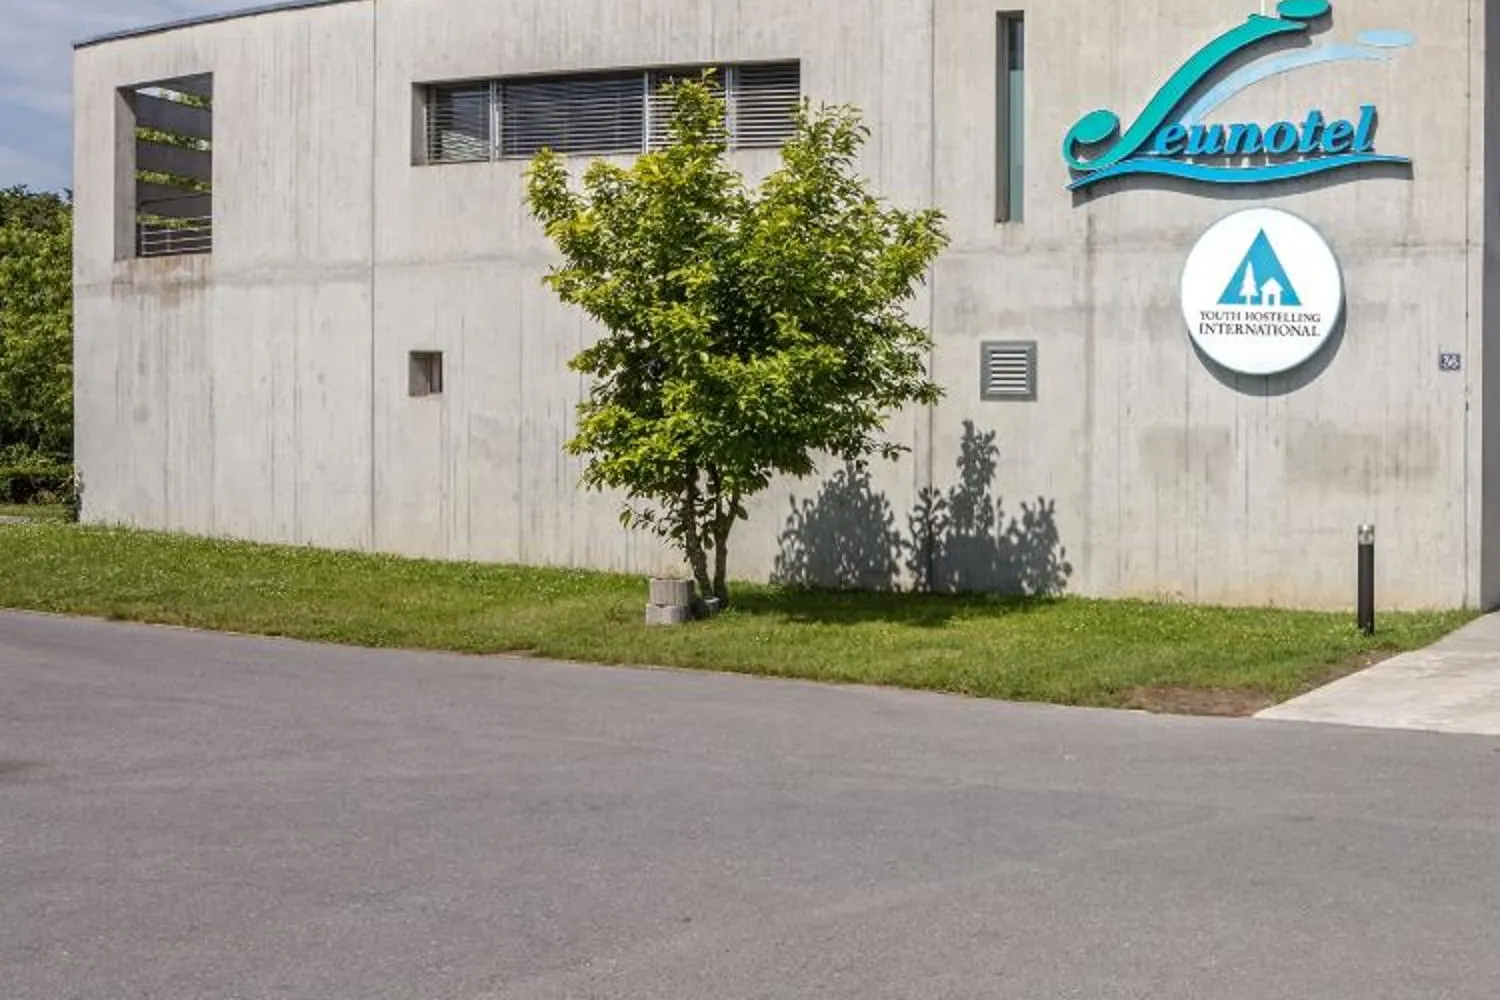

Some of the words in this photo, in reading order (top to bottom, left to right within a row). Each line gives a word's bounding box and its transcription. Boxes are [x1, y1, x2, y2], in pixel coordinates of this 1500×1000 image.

[1199, 310, 1241, 321] YOUTH
[1245, 311, 1321, 323] HOSTELLING
[1199, 322, 1321, 337] INTERNATIONAL
